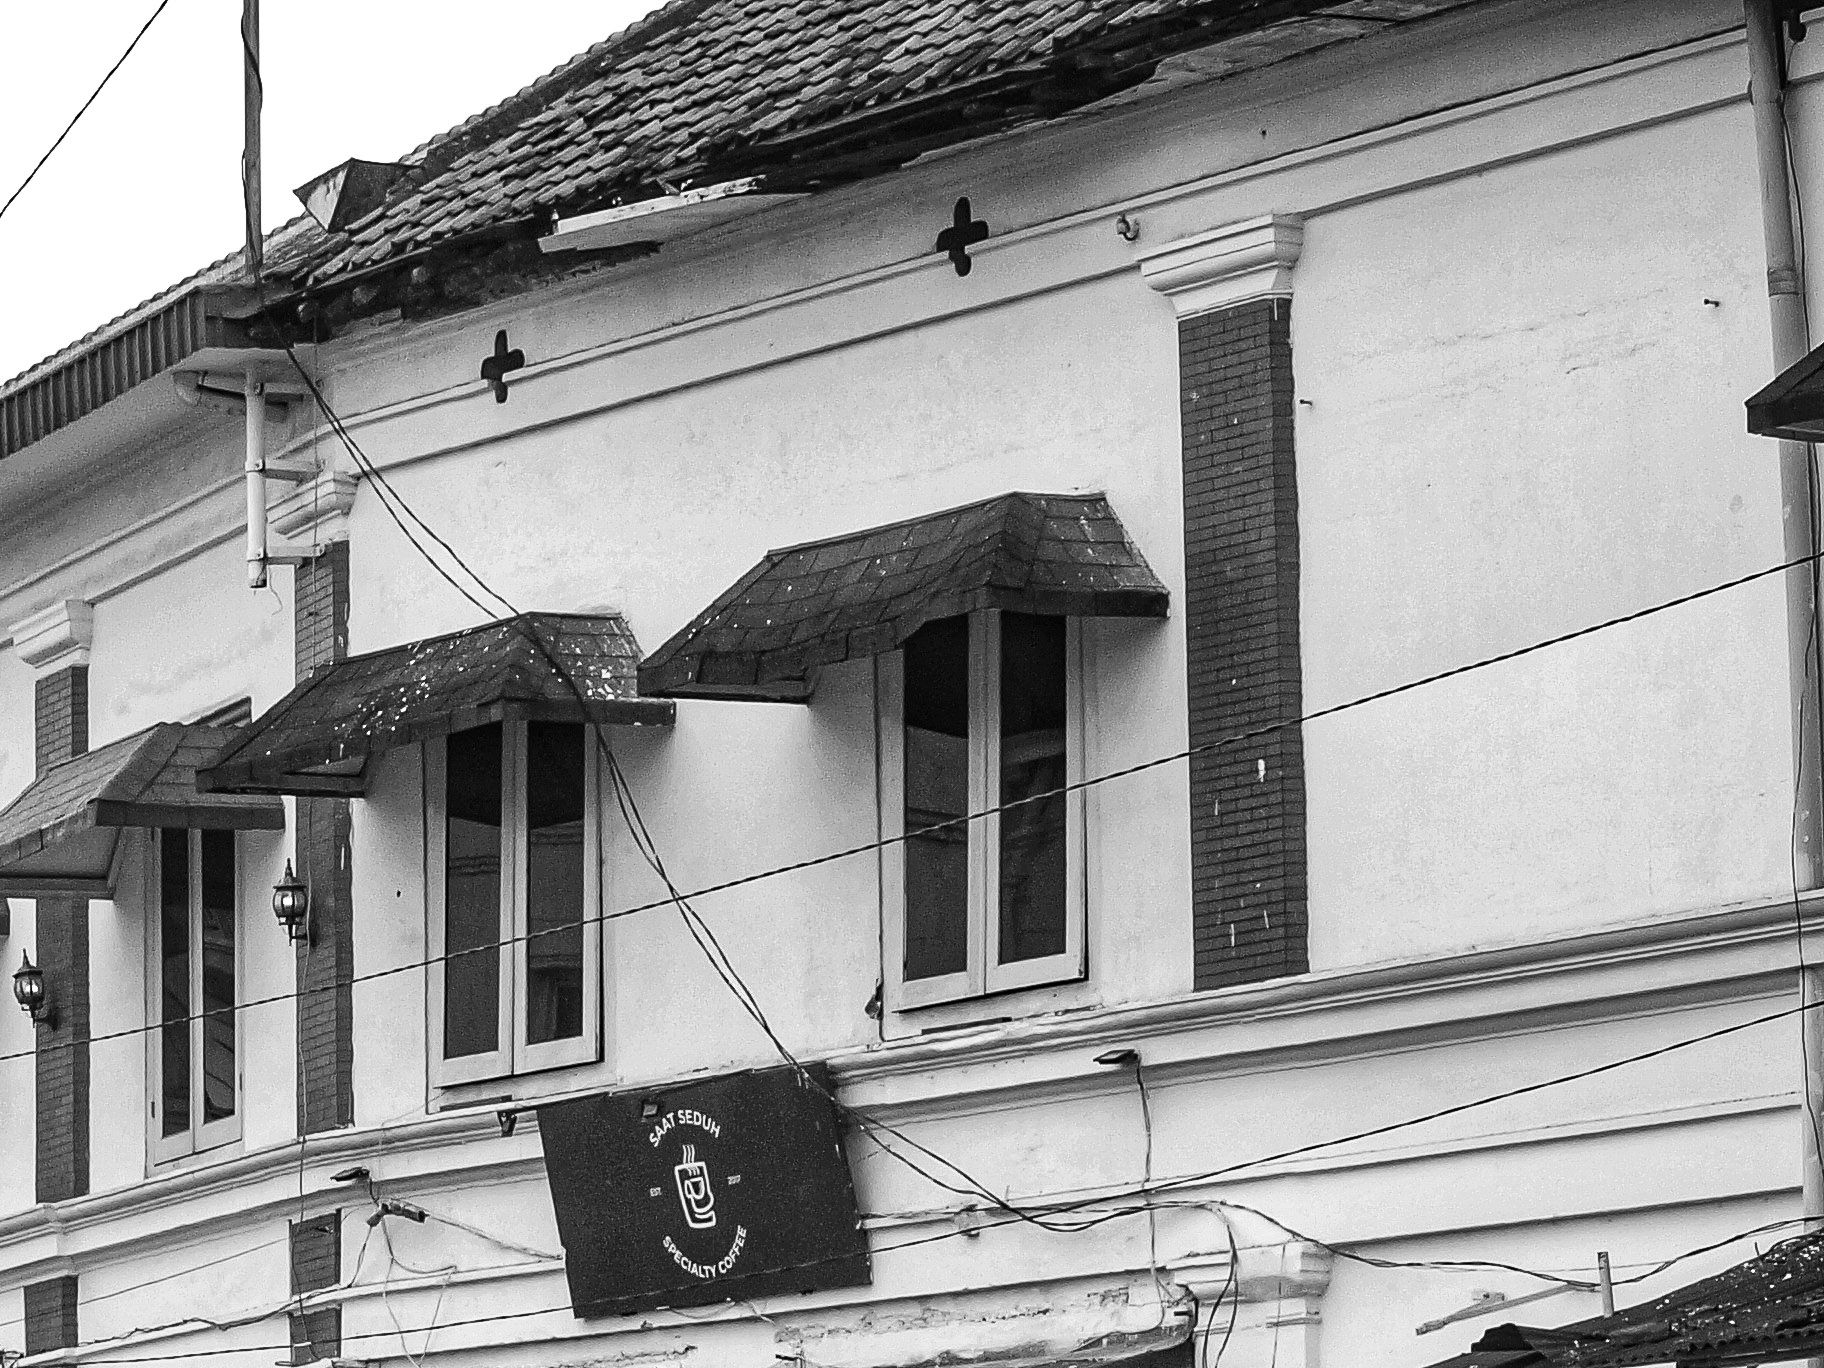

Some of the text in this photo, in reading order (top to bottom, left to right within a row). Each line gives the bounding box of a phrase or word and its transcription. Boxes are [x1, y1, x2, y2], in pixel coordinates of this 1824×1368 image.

[649, 1109, 721, 1147] SAAT SEDUH
[663, 1225, 747, 1279] SPECIALTY COFFEE
